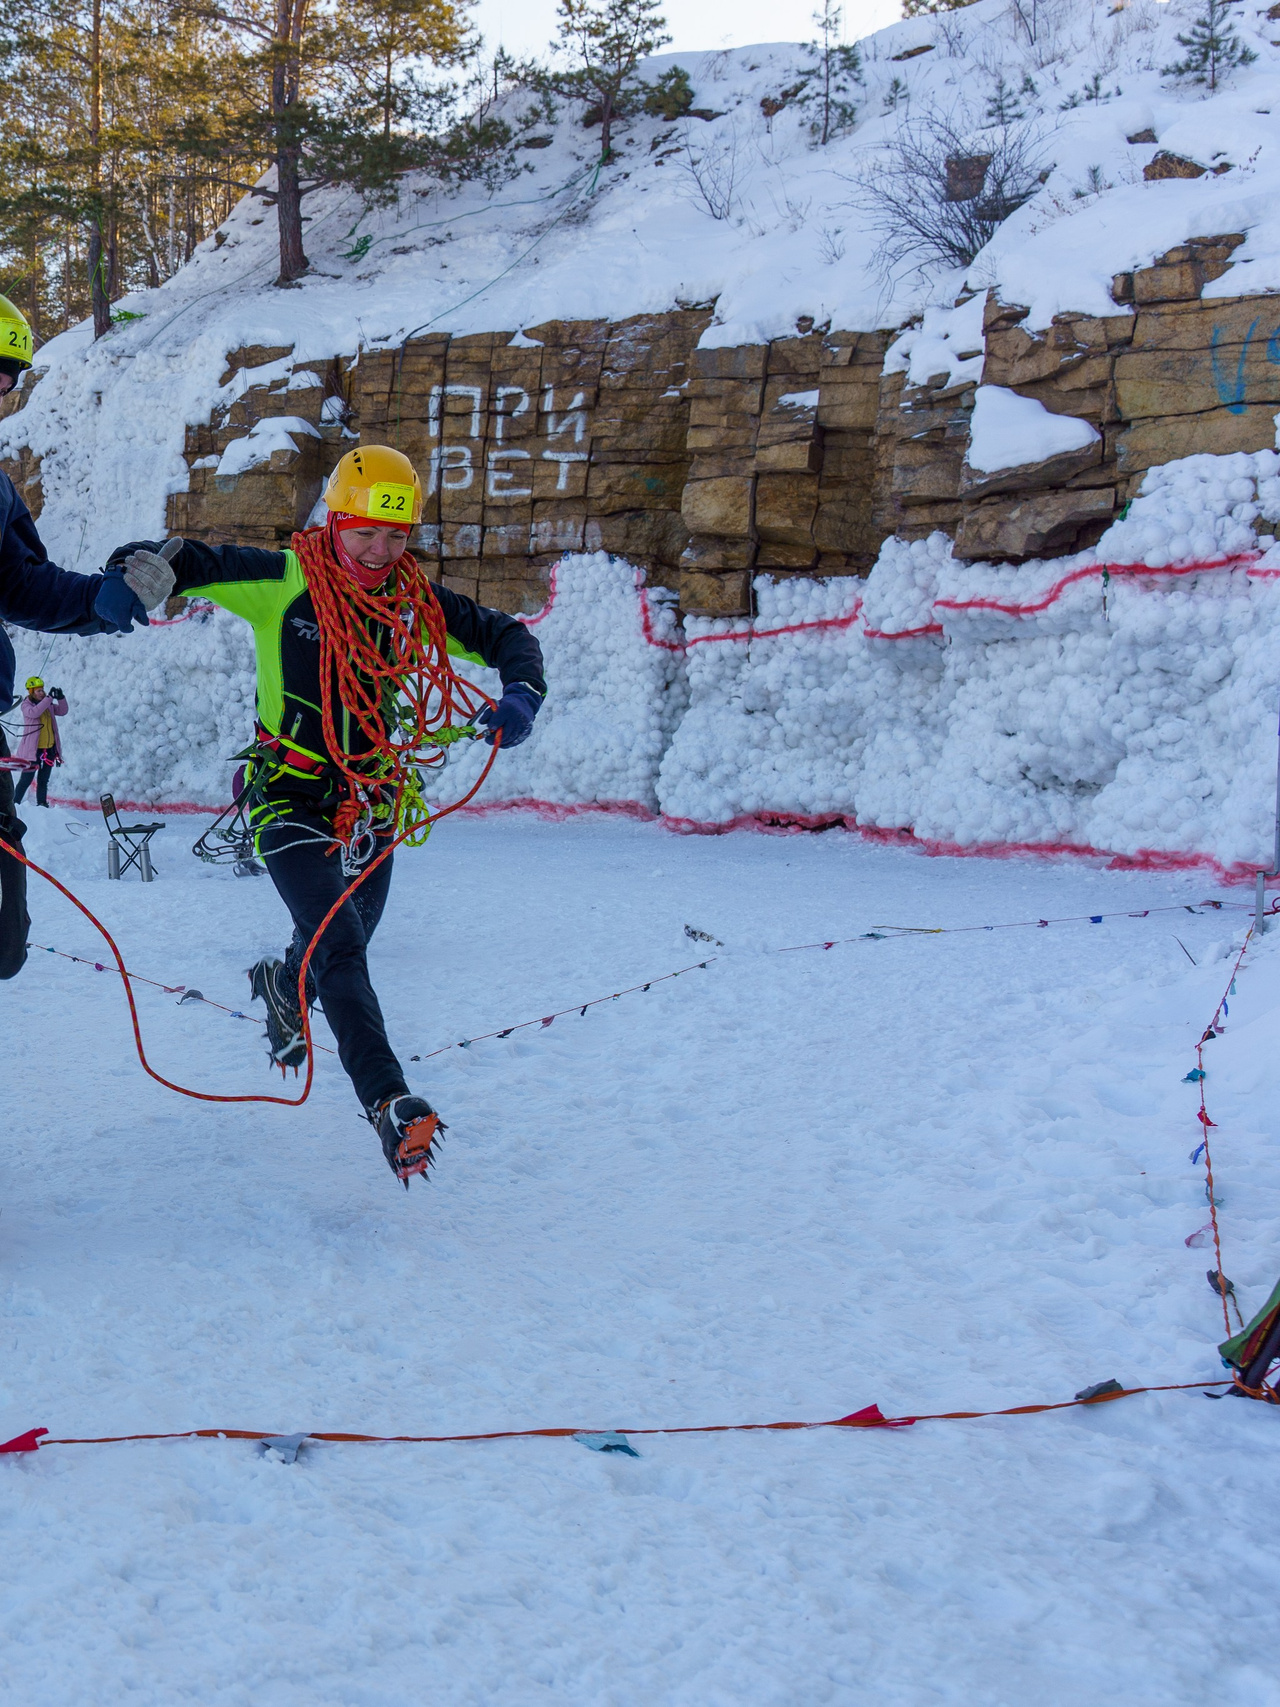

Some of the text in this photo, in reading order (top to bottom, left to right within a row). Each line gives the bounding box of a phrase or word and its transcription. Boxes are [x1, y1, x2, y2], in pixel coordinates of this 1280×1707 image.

[9, 331, 27, 350] 2.1
[428, 383, 587, 445] ПРИ
[427, 446, 593, 497] ВЕТ
[380, 494, 405, 511] 2.2
